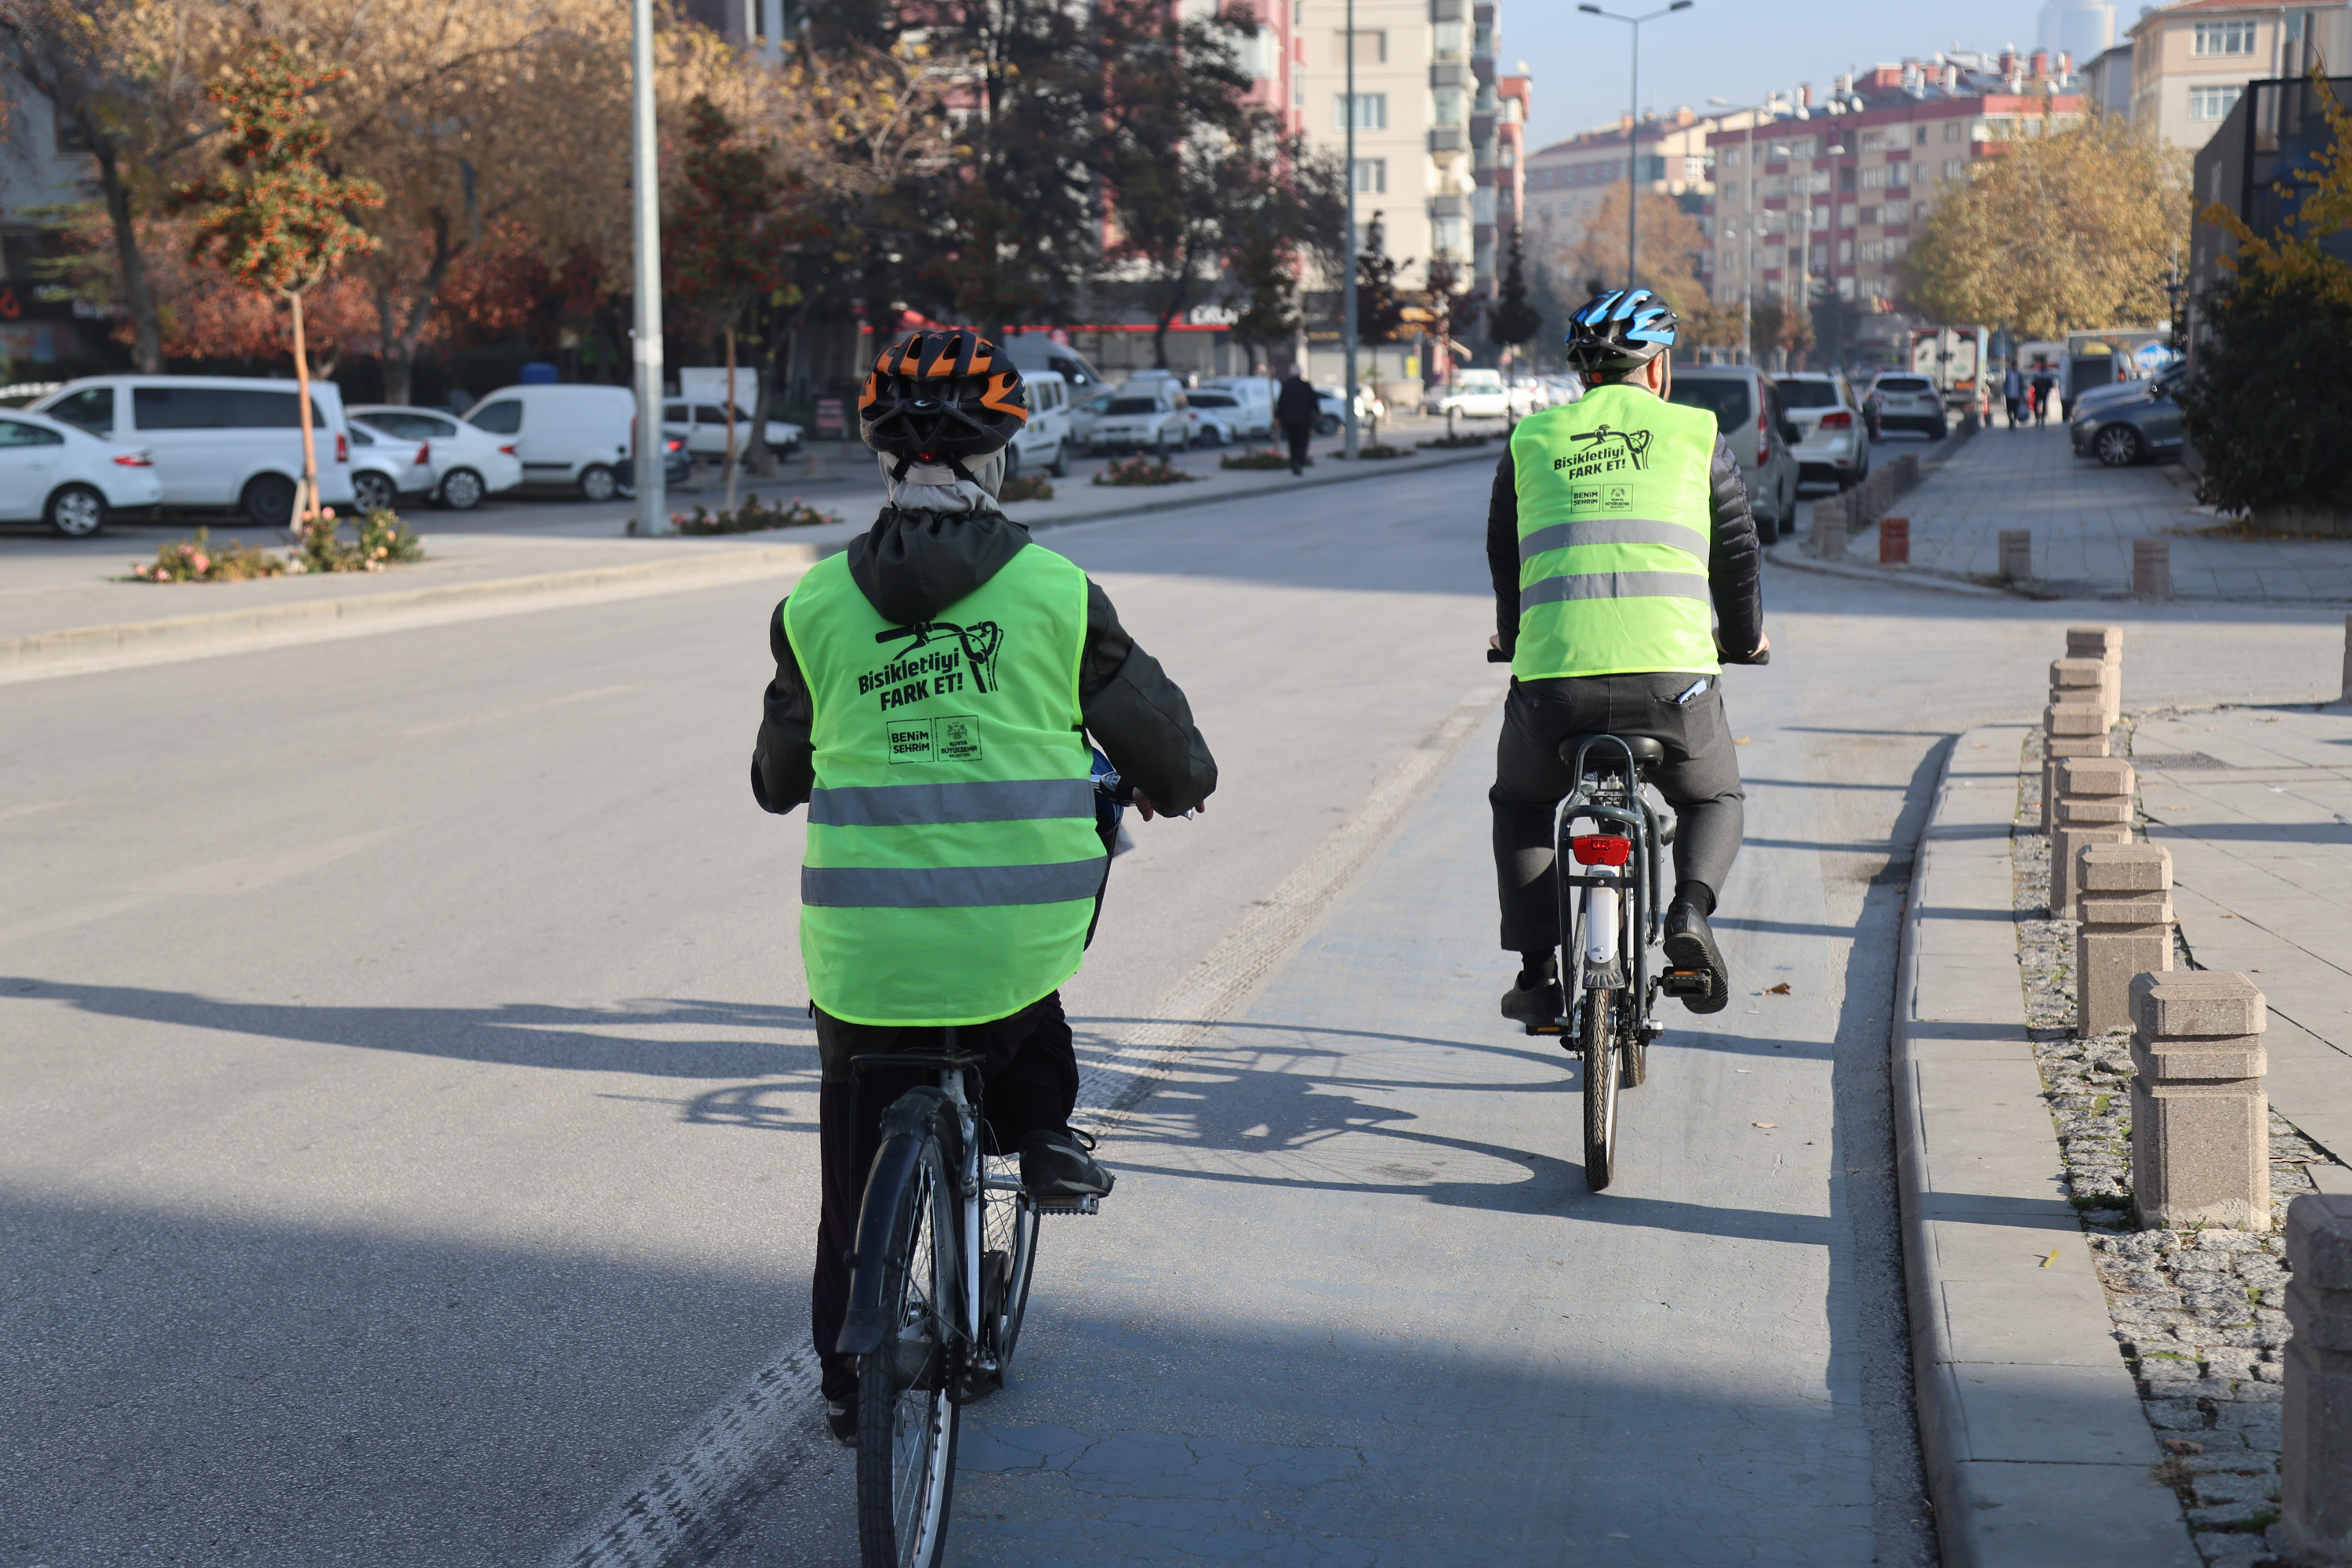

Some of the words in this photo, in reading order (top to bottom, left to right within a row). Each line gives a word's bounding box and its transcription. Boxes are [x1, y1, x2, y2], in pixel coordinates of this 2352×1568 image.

[1554, 445, 1624, 470] Bisikletliyi
[1569, 462, 1602, 480] FARK
[1606, 459, 1626, 471] ET!
[858, 648, 960, 695] Bisikletliyi
[880, 679, 930, 712] FARK
[934, 672, 964, 695] ET!
